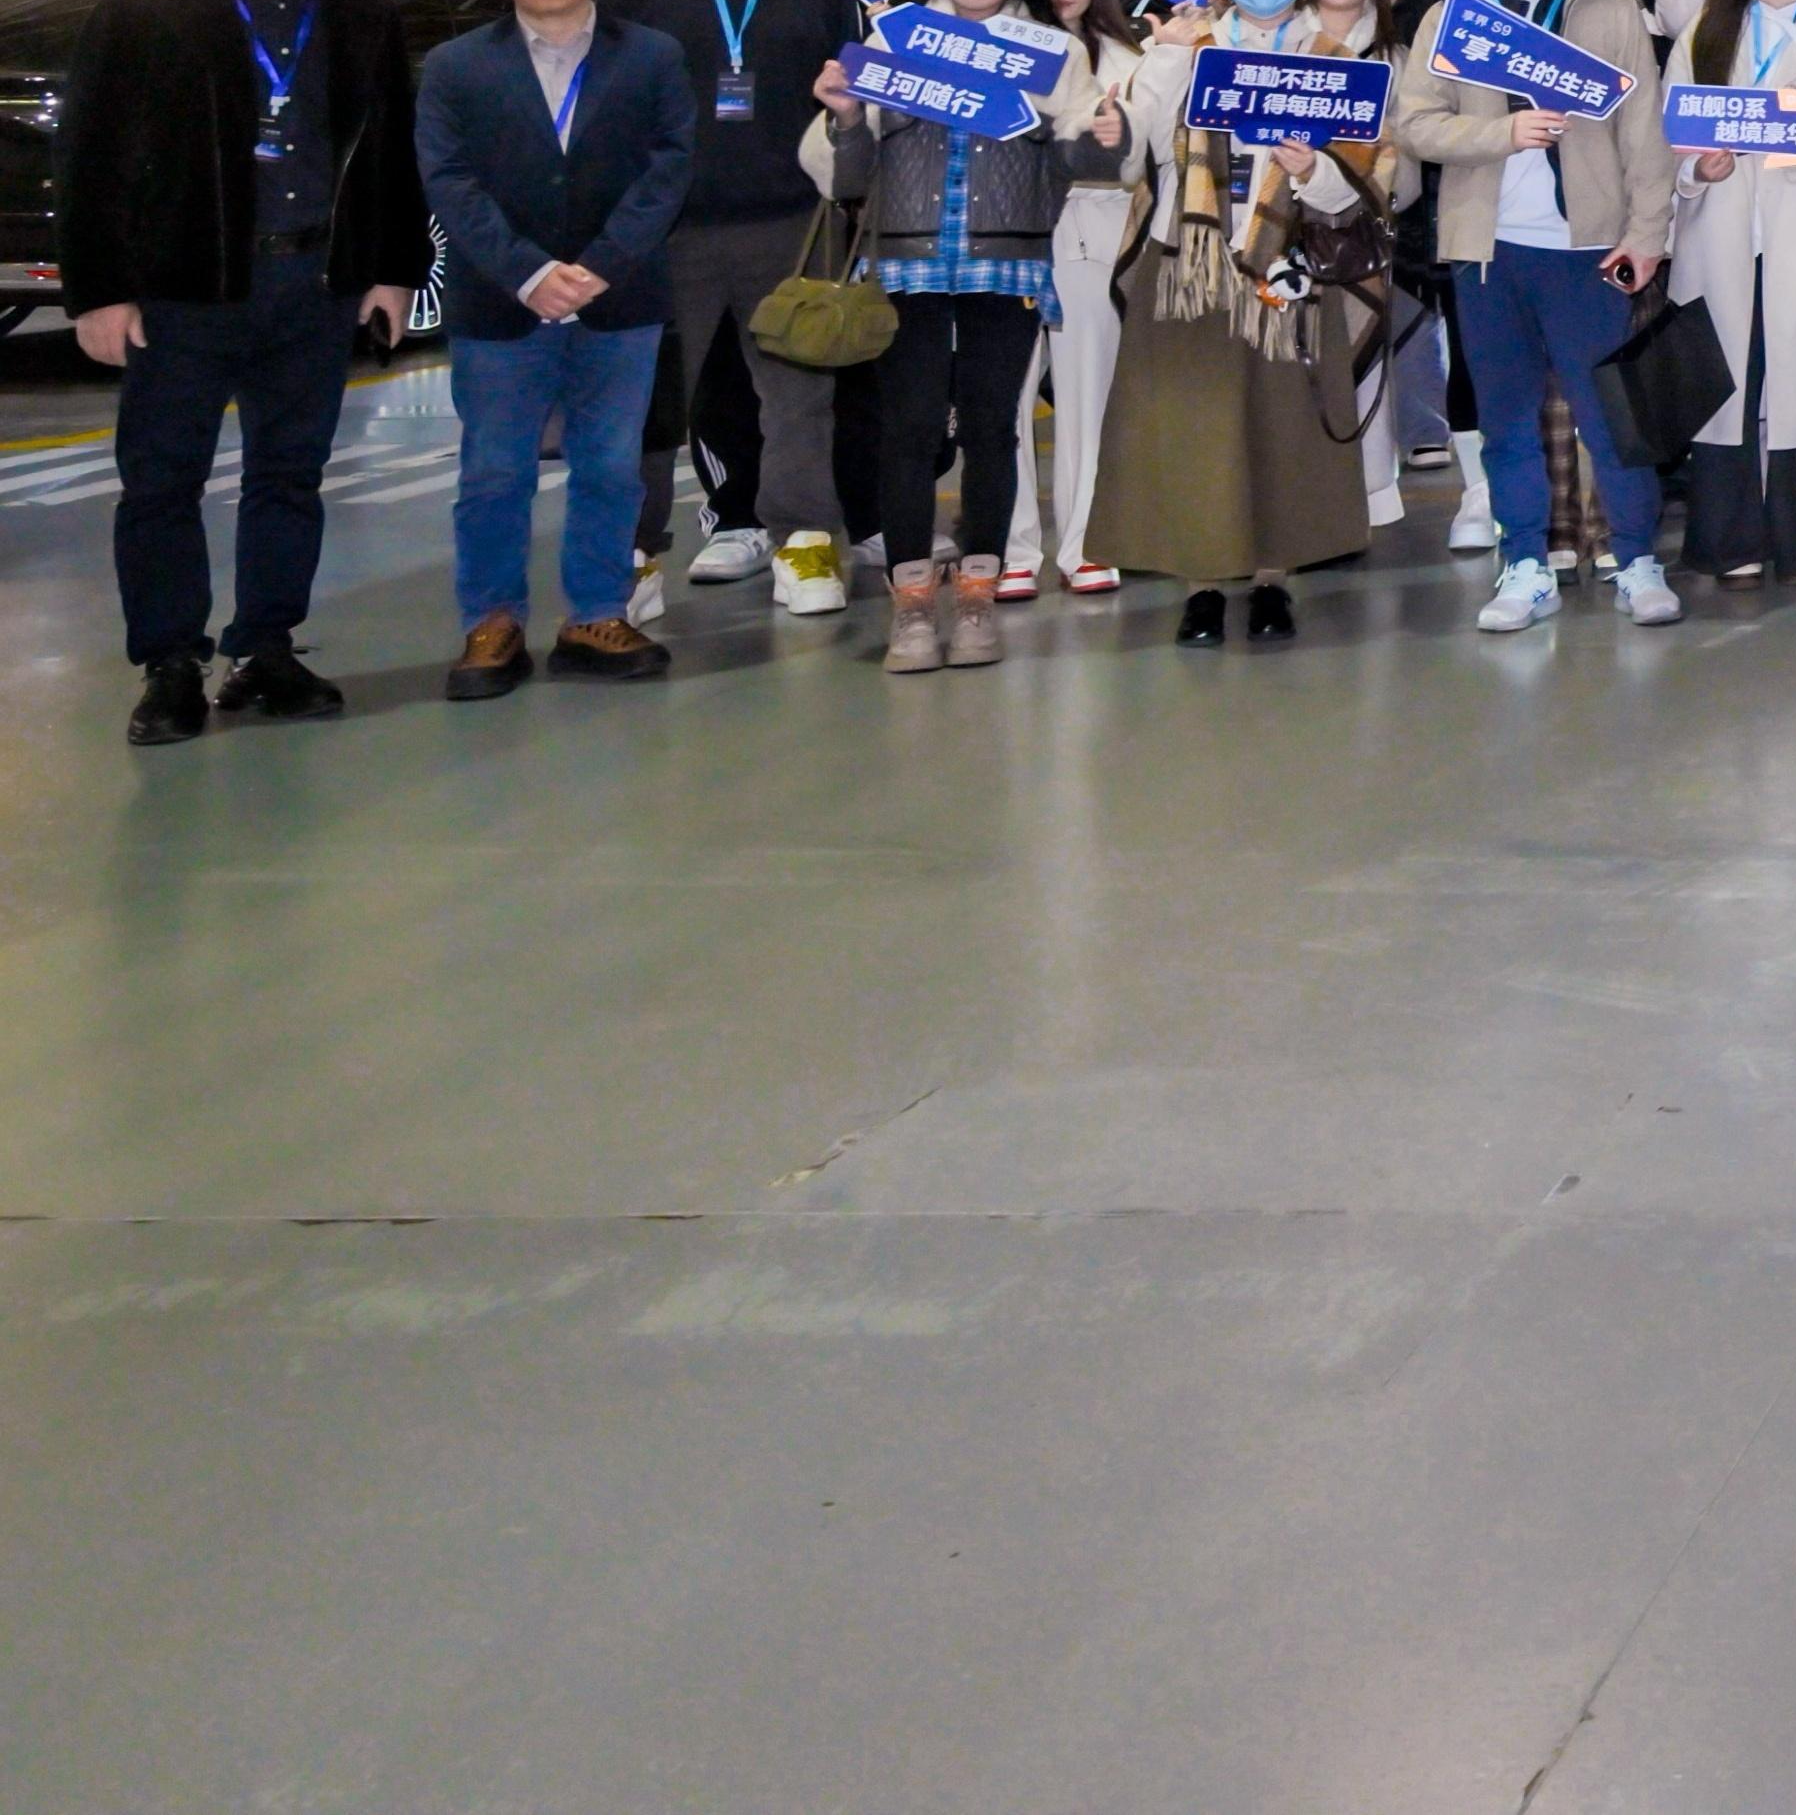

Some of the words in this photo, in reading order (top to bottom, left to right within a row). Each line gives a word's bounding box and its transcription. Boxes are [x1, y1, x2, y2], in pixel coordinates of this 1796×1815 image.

[1000, 21, 1026, 37] 享界
[1032, 28, 1054, 46] S9
[1461, 9, 1490, 27] 享界
[1491, 20, 1512, 37] S9
[906, 24, 1036, 79] 闪耀寰宇
[853, 62, 986, 119] 星河随行
[1233, 63, 1348, 94] 通勤不赶早
[1202, 86, 1377, 123] 「享」得每段从容
[1677, 94, 1767, 120] 旗舰9系
[1255, 127, 1285, 142] 享界
[1290, 129, 1311, 143] S9
